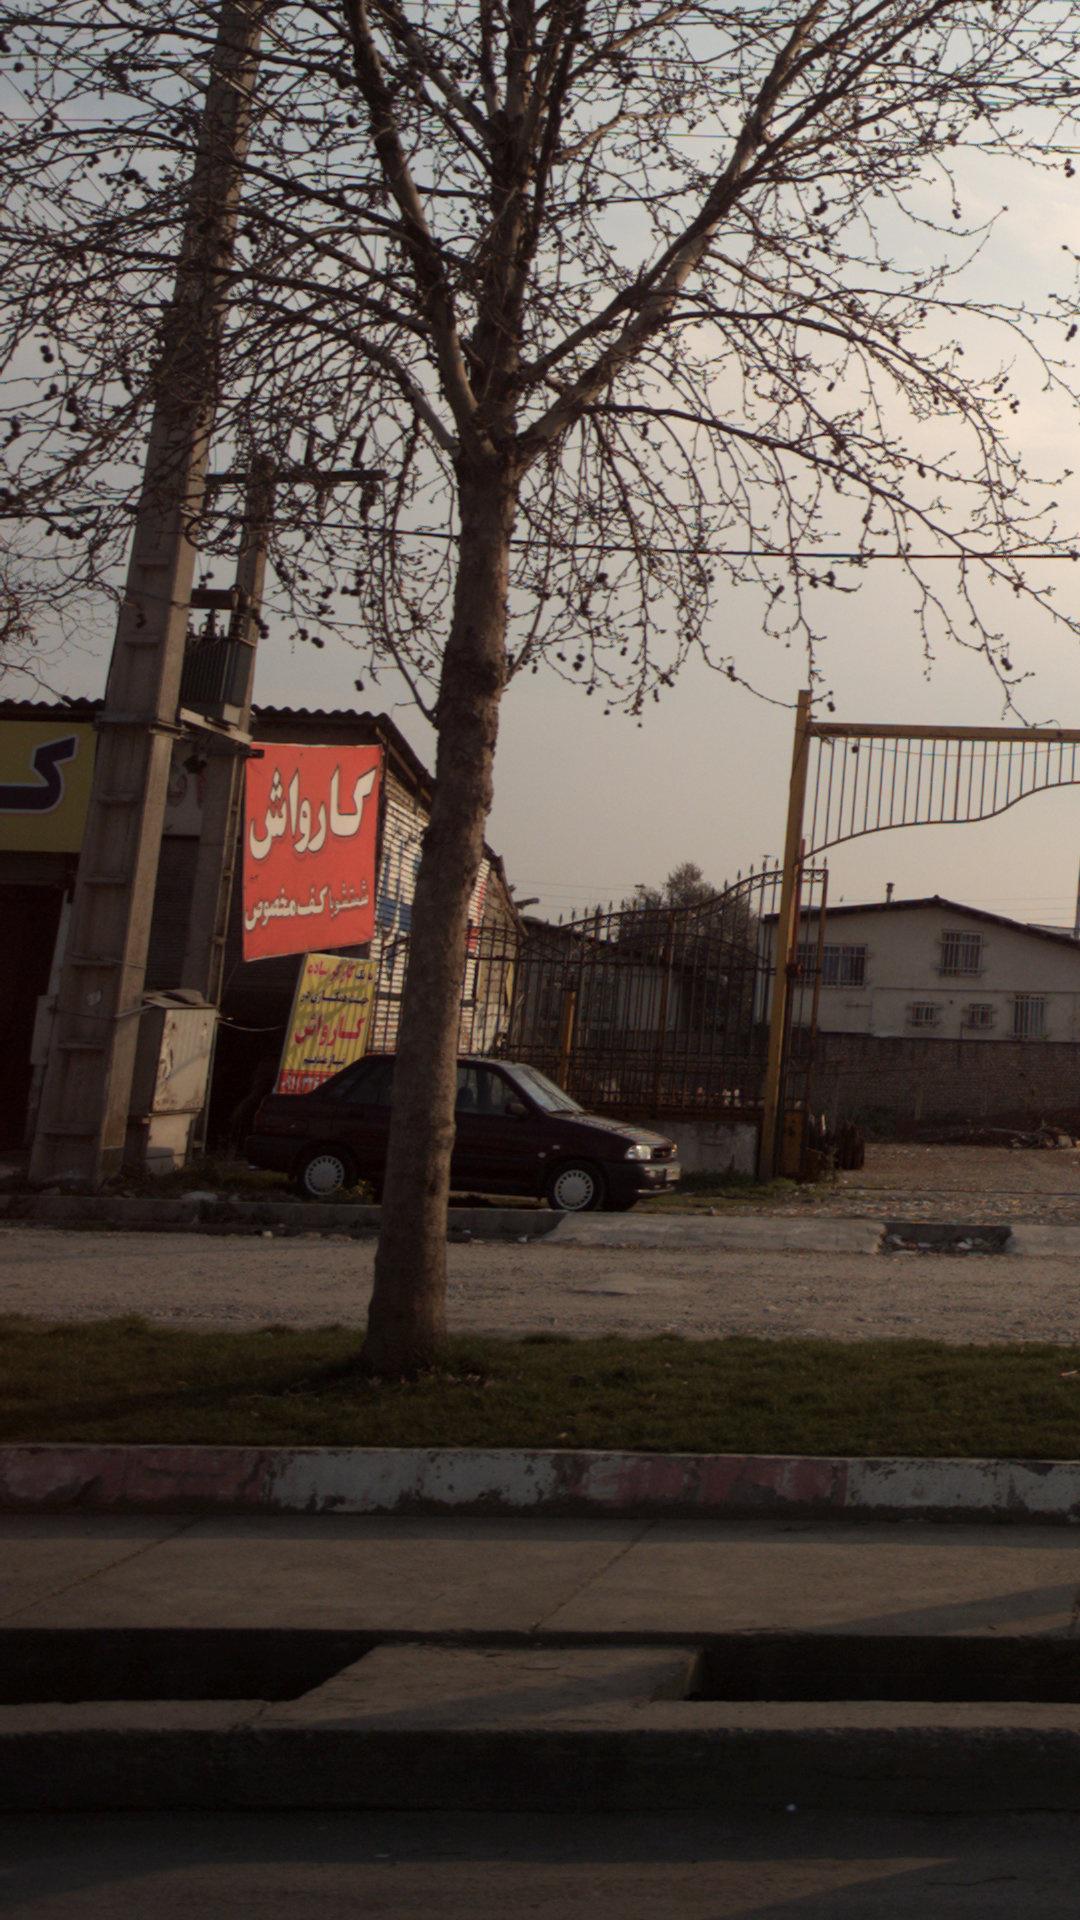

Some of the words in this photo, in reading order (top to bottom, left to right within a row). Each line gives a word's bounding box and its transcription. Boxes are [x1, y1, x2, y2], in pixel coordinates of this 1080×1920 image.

[249, 765, 377, 860] کارواش
[244, 888, 297, 931] مخصوص
[297, 885, 328, 915] کف
[307, 960, 328, 976] ساده
[294, 1013, 366, 1047] کارواش
